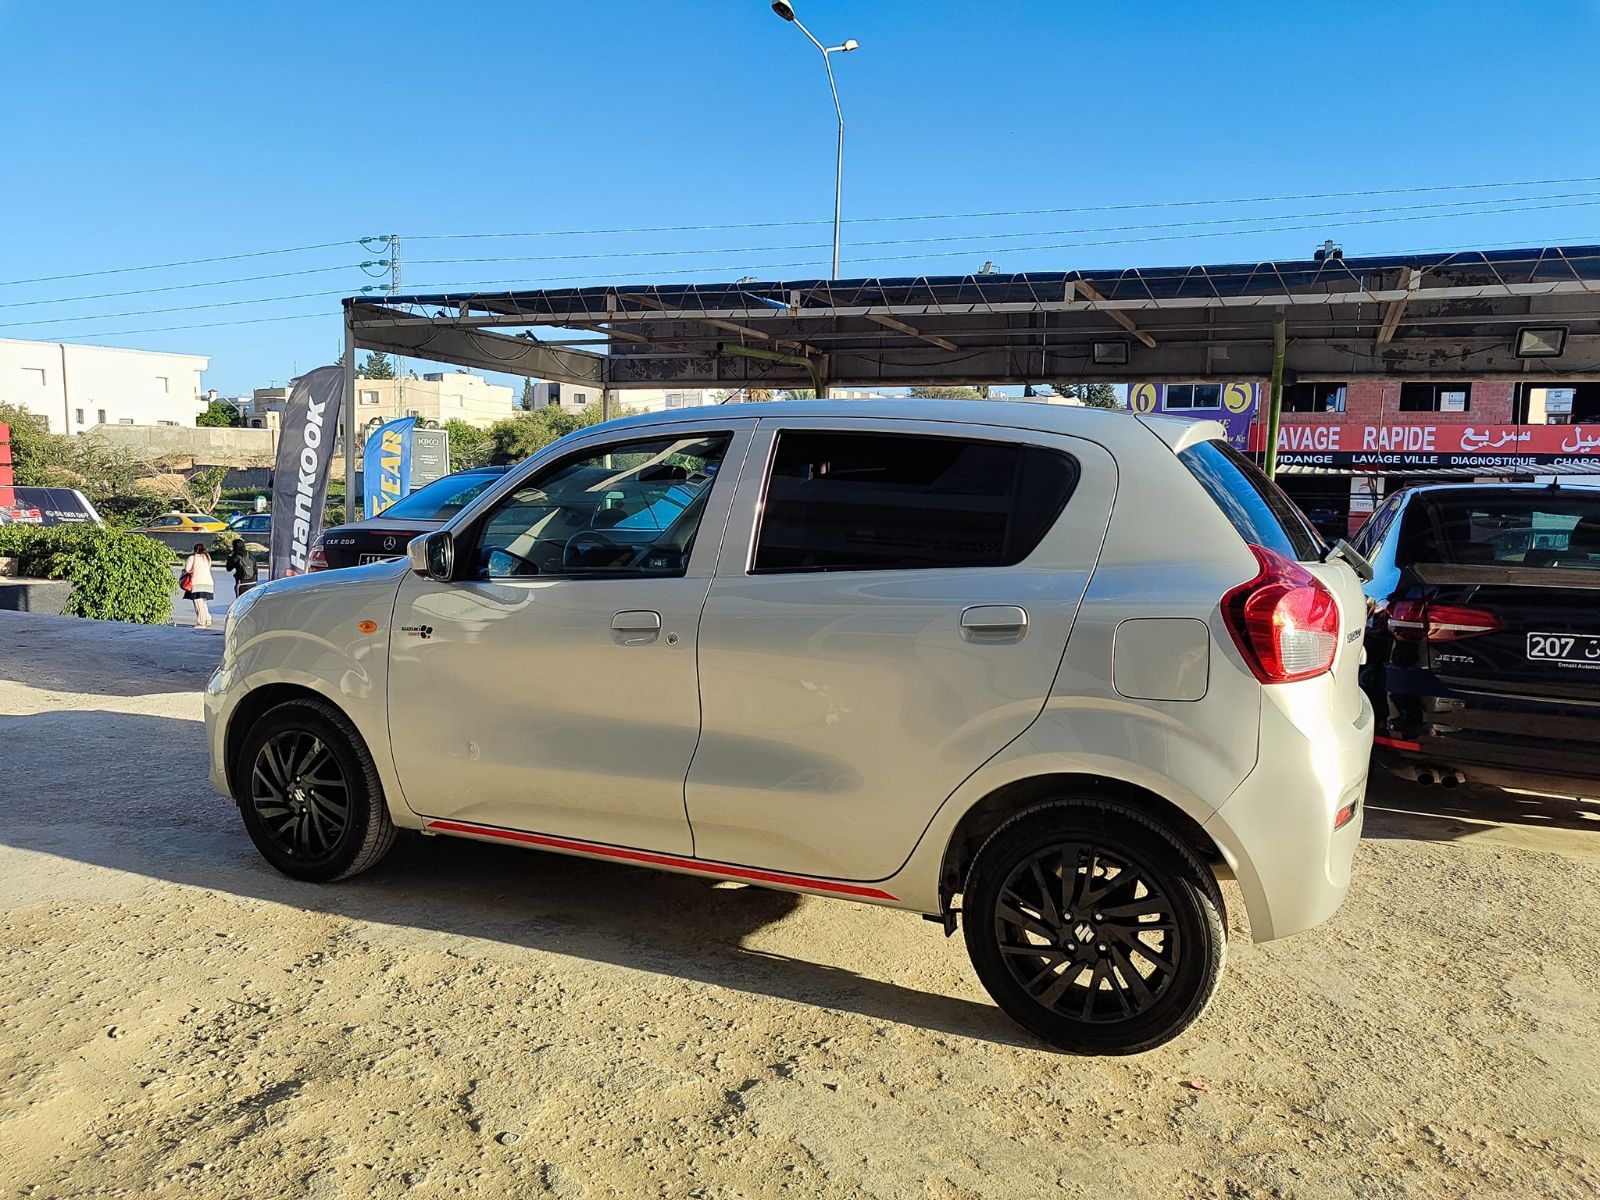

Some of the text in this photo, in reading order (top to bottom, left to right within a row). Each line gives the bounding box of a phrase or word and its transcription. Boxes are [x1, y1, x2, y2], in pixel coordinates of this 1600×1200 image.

[1136, 384, 1150, 412] 6
[1228, 383, 1247, 410] 5
[418, 438, 439, 446] KIKO
[1277, 426, 1437, 451] AVAGE RAPIDE
[1460, 427, 1531, 451] سريع
[1352, 455, 1439, 465] LAVAGE VILLE
[1450, 456, 1537, 467] DIAGNOSTIQUE
[1530, 636, 1575, 657] 207
[1434, 654, 1475, 664] JETTA
